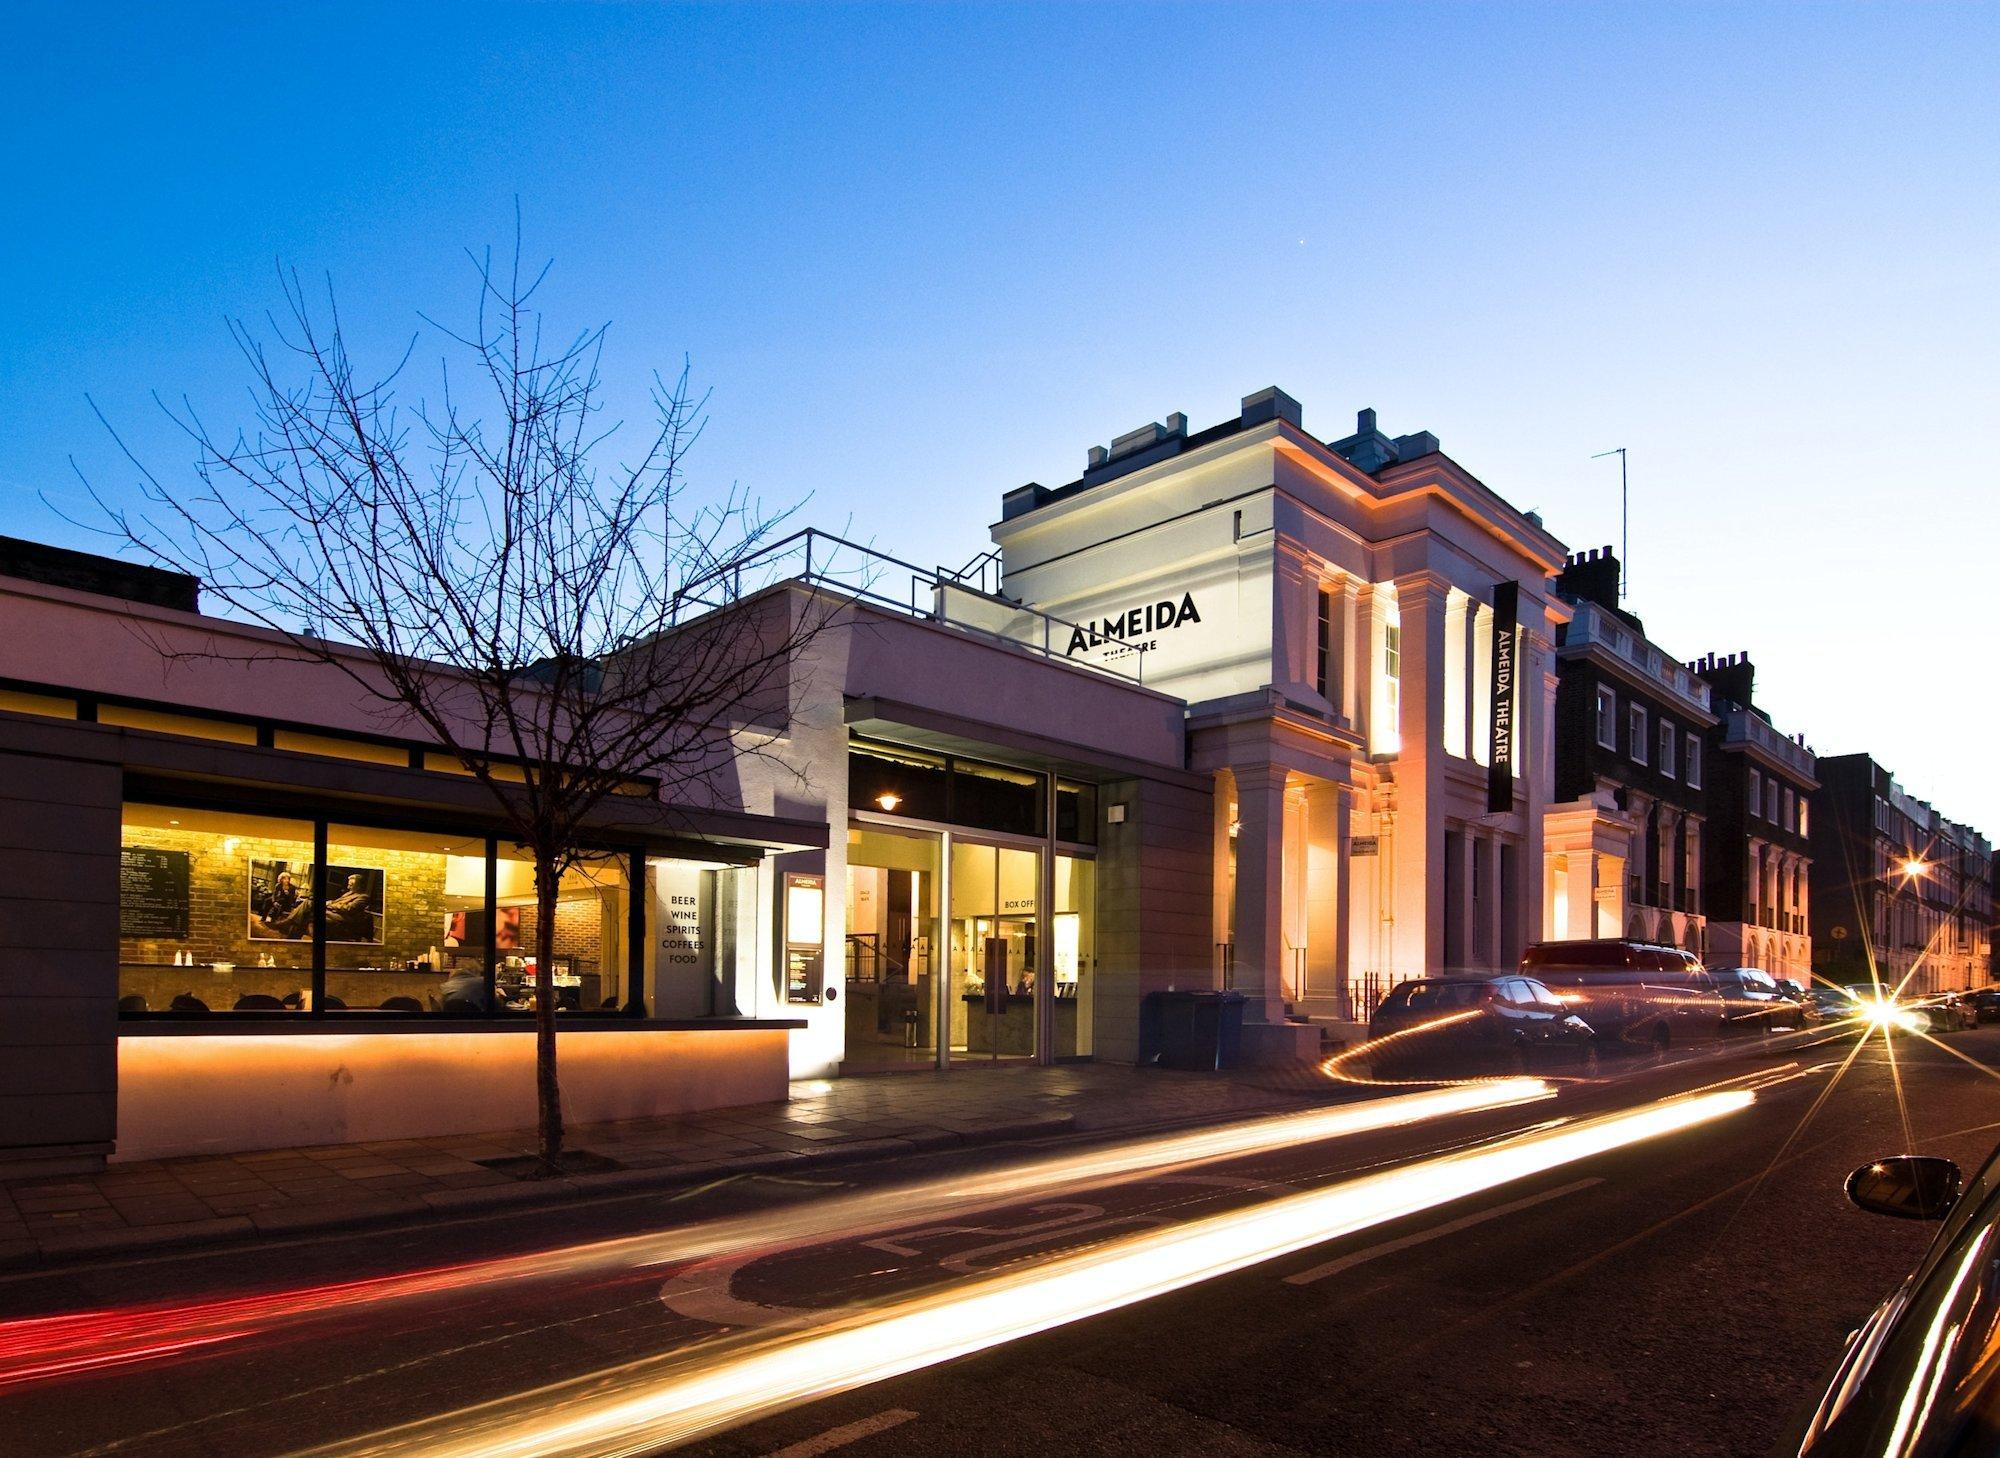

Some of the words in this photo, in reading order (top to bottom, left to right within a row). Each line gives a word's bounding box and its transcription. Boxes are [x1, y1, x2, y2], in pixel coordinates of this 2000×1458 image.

[1066, 591, 1201, 656] ALMEIDA
[1496, 630, 1512, 695] ALMEIDA
[1495, 699, 1510, 764] THEATRE
[671, 896, 696, 905] BEER
[671, 911, 697, 920] WINE
[666, 925, 700, 935] SPIRITS
[662, 940, 704, 949] COFFEES
[669, 955, 697, 964] FOOD
